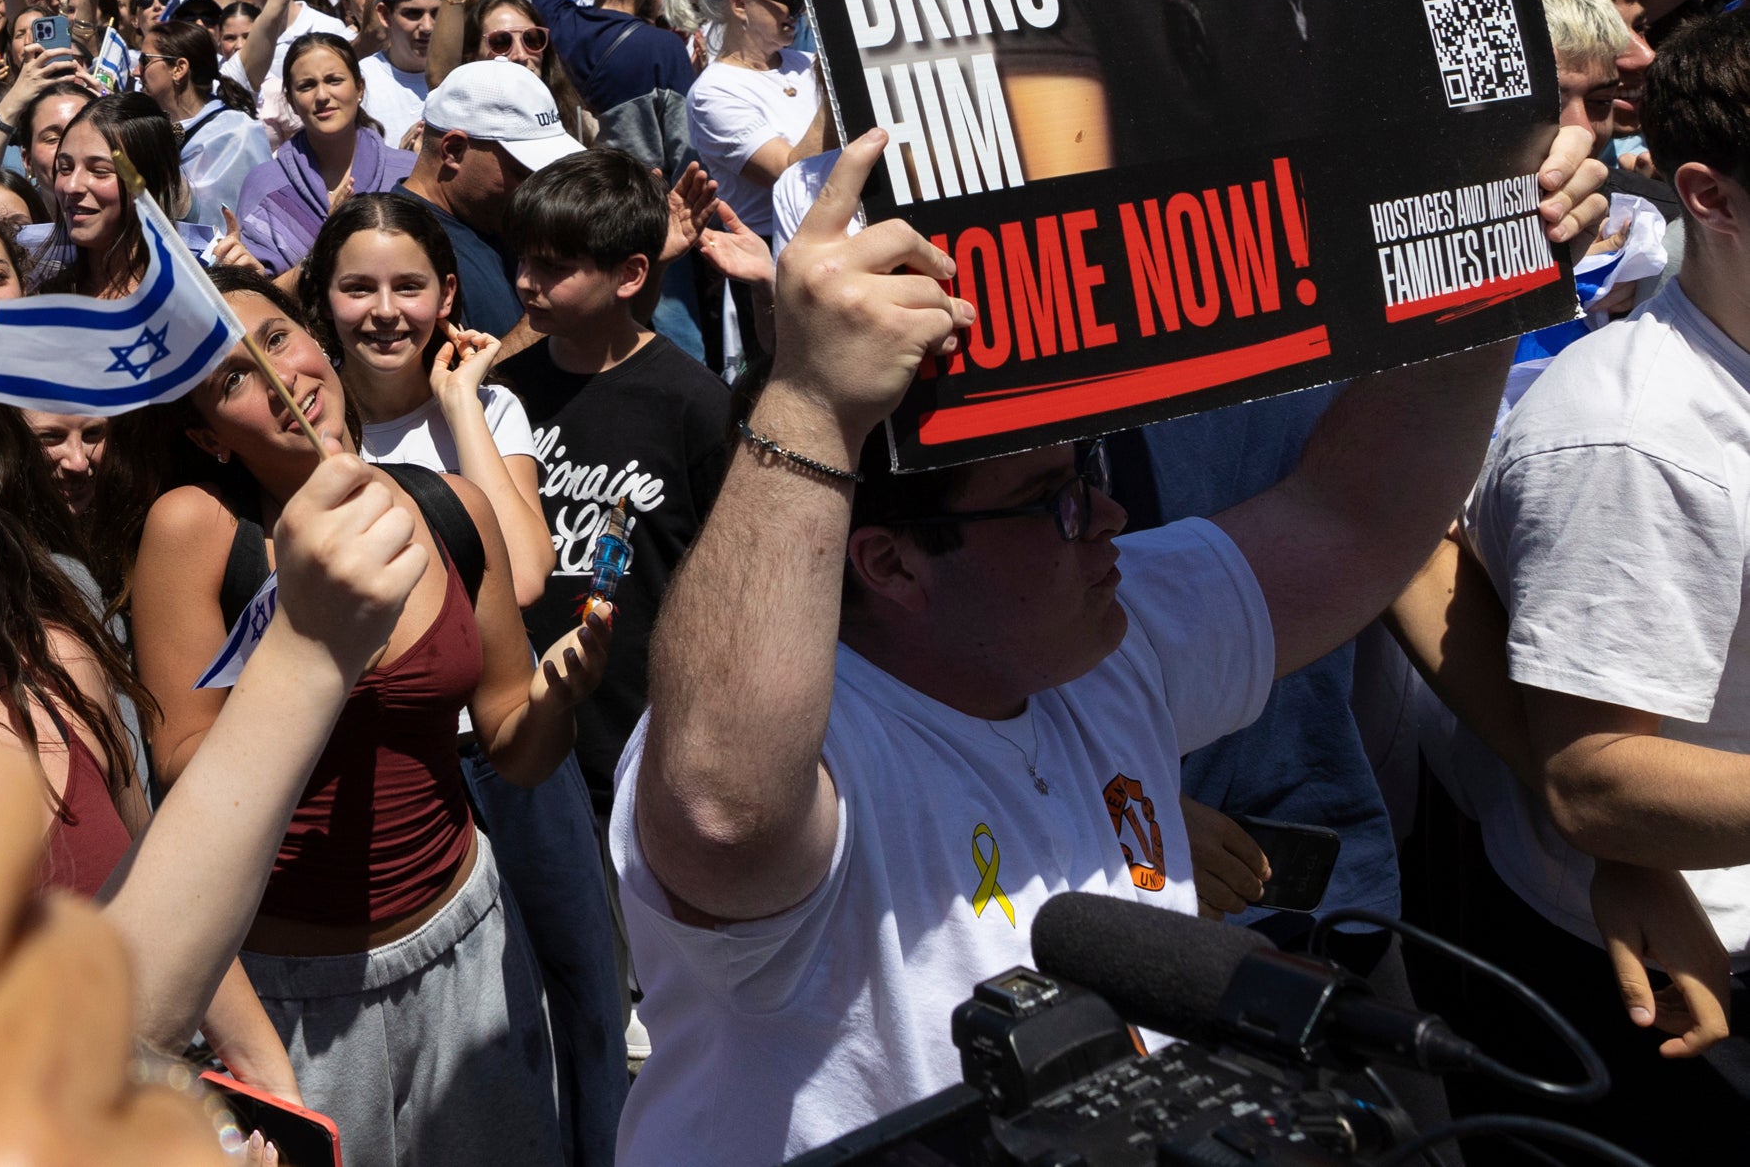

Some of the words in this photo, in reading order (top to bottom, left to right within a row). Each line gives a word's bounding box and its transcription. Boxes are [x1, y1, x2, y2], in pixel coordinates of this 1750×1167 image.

[863, 52, 1026, 207] HIM
[1117, 156, 1318, 338] NOW!
[1369, 189, 1456, 244] HOSTAGES
[1454, 183, 1487, 228] AND
[1377, 229, 1485, 308] FAMILIES
